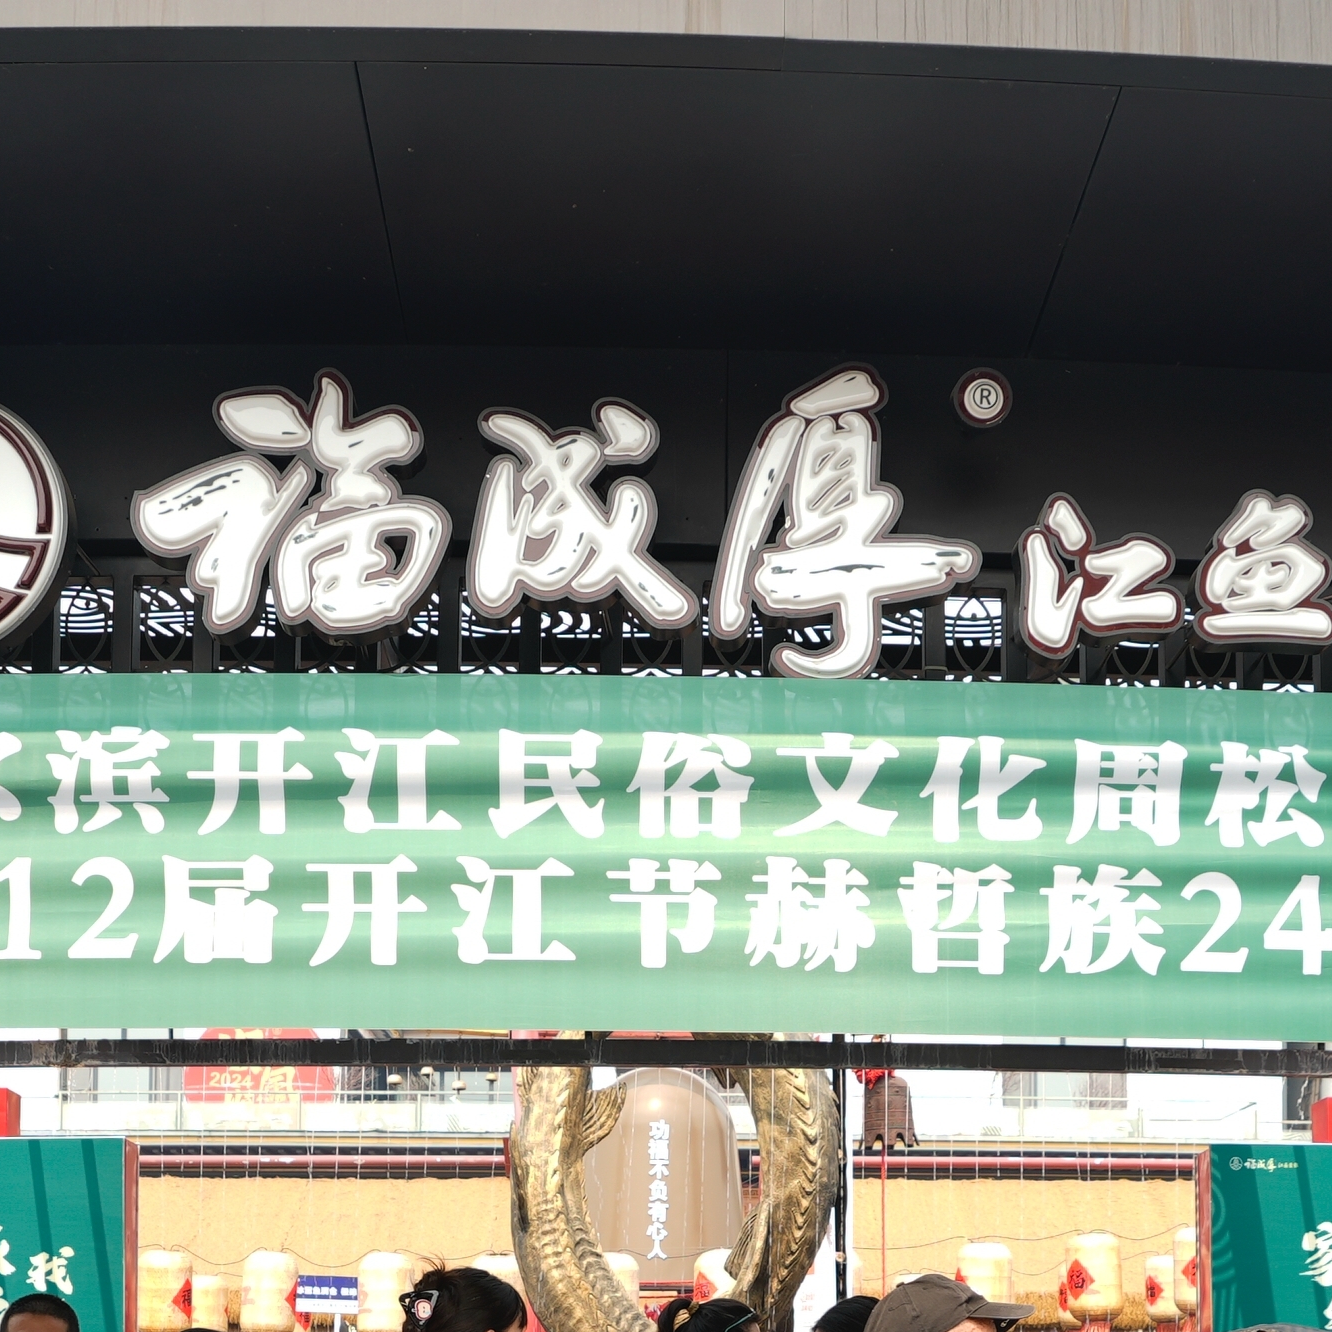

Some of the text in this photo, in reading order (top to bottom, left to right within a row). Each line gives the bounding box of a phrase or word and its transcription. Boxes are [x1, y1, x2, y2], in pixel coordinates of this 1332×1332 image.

[137, 369, 977, 676] 福成厚
[209, 1072, 254, 1088] 2024
